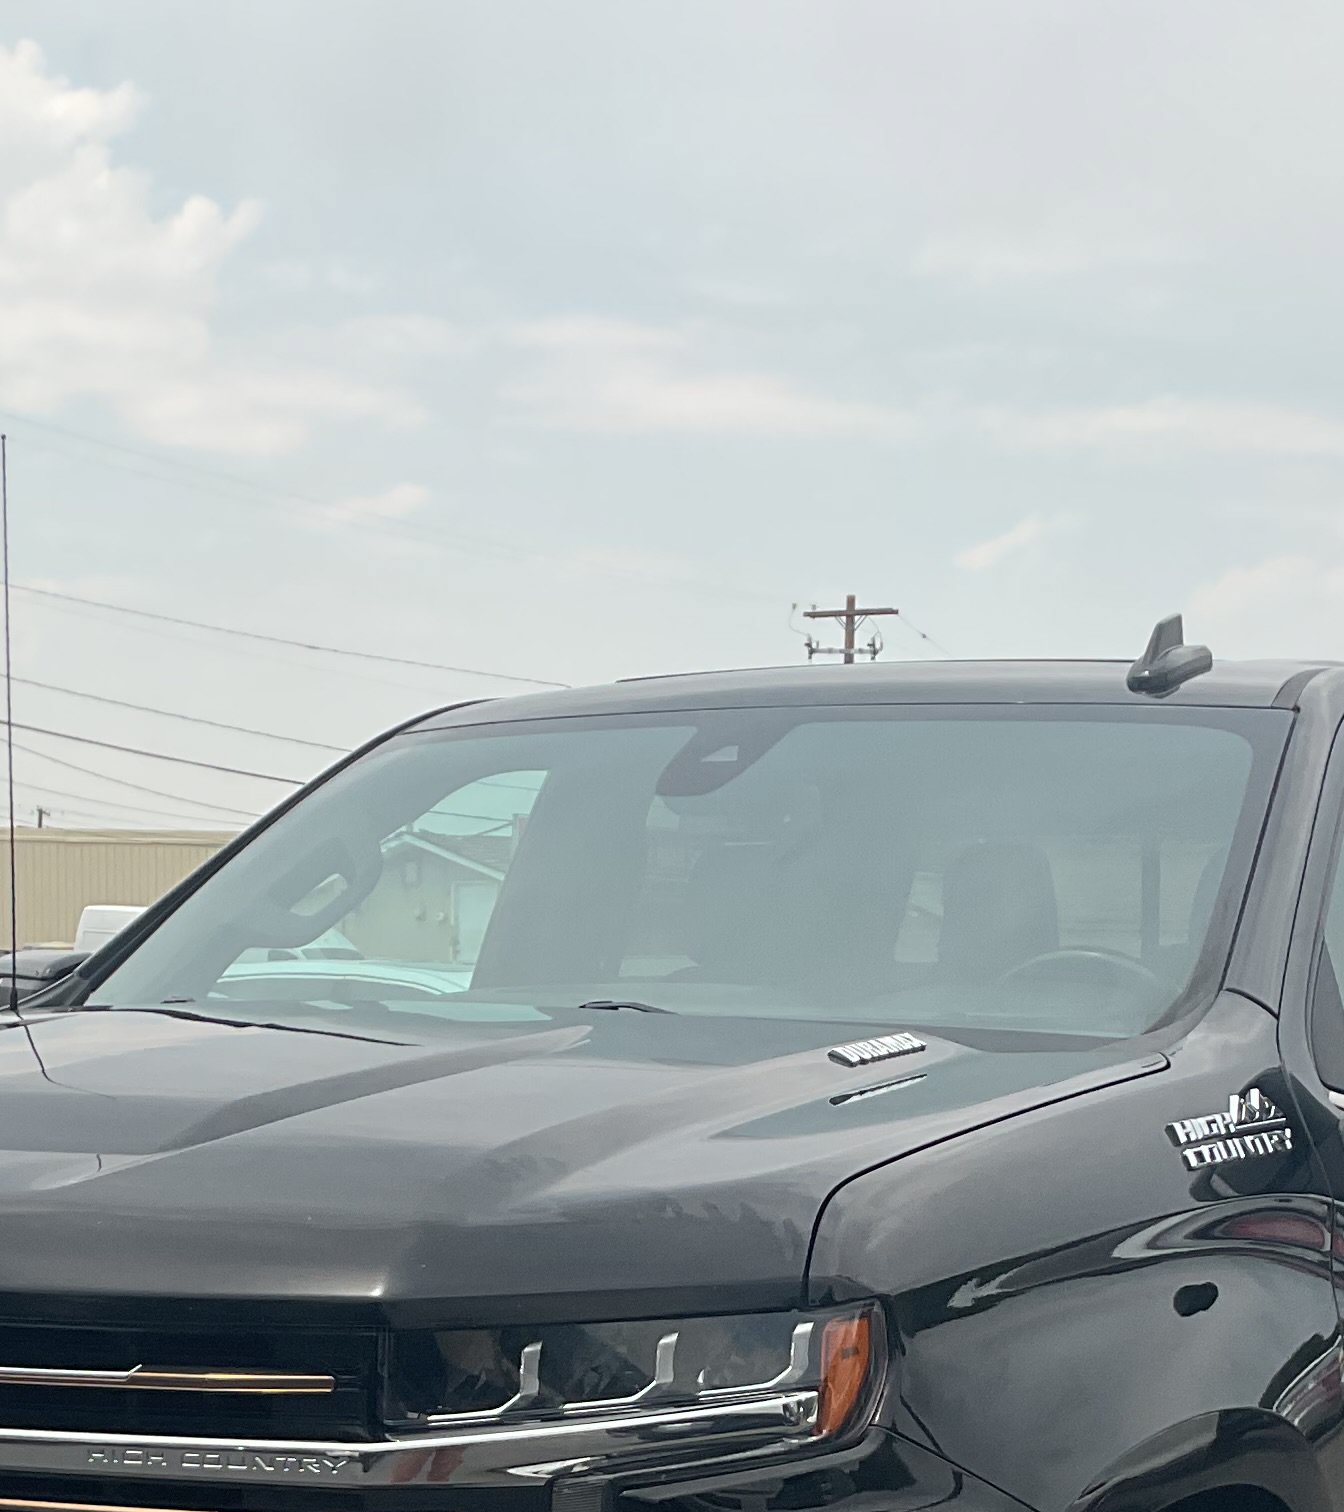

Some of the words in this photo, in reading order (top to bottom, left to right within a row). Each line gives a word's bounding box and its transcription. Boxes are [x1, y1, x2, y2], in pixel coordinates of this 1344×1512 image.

[828, 1032, 928, 1066] DURAMAX
[1167, 1112, 1237, 1146] HIGH
[1181, 1127, 1293, 1169] COUNTRY
[88, 1447, 167, 1467] HIGH
[181, 1453, 349, 1475] COUNTRY
